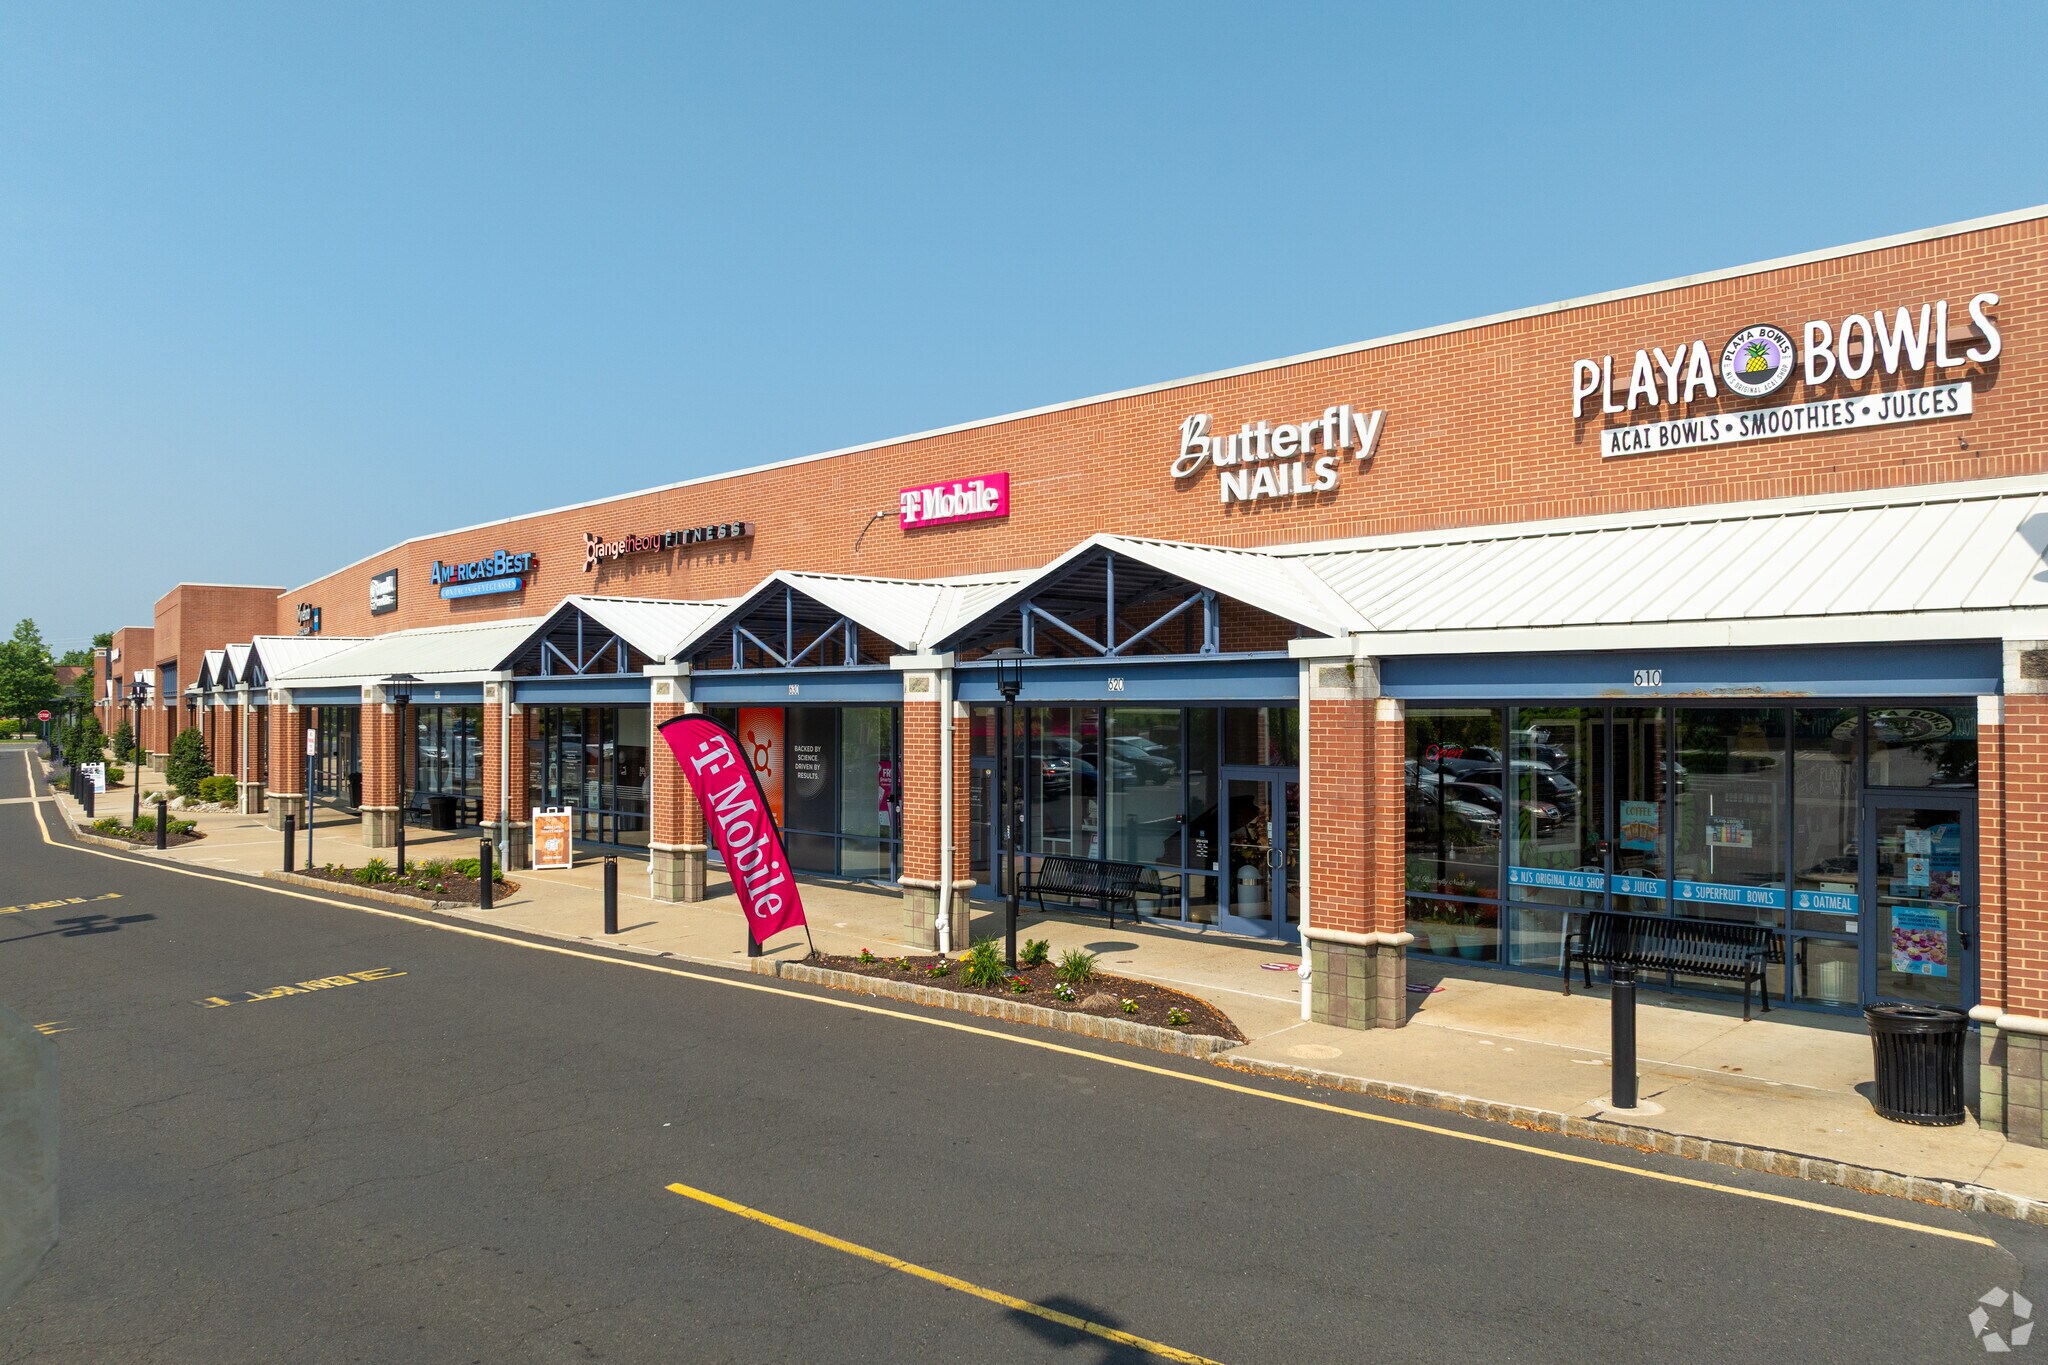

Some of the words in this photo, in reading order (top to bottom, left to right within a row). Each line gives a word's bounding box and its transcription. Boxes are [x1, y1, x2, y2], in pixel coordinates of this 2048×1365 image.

[1573, 340, 1718, 418] PLAYA
[1804, 293, 2001, 386] BOWLS
[1725, 331, 1754, 361] PLAYA
[1759, 329, 1790, 353] BOWLS
[1735, 382, 1761, 394] ORIGINAL
[1776, 364, 1789, 380] SHOP
[1611, 428, 1651, 453] ACAI
[1660, 420, 1720, 447] BOWLS
[1740, 401, 1856, 437] SMOOTHIES
[1878, 388, 1959, 420] JUICES
[1170, 404, 1387, 479] Butterfly
[1220, 456, 1340, 503] NAILS
[665, 521, 743, 548] FITNESS
[1108, 678, 1124, 692] 620
[1634, 670, 1662, 687] 610
[1425, 744, 1465, 761] Open
[1521, 871, 1533, 883] NJ'S
[1536, 873, 1566, 887] ORIGINAL
[1569, 875, 1584, 887] ACAI
[1587, 876, 1605, 889] SHOP
[1633, 881, 1657, 894] JUICES
[1695, 886, 1741, 901] SUPERFRUIT
[1747, 890, 1774, 905] BOWLS
[1813, 895, 1852, 911] OATMEAL
